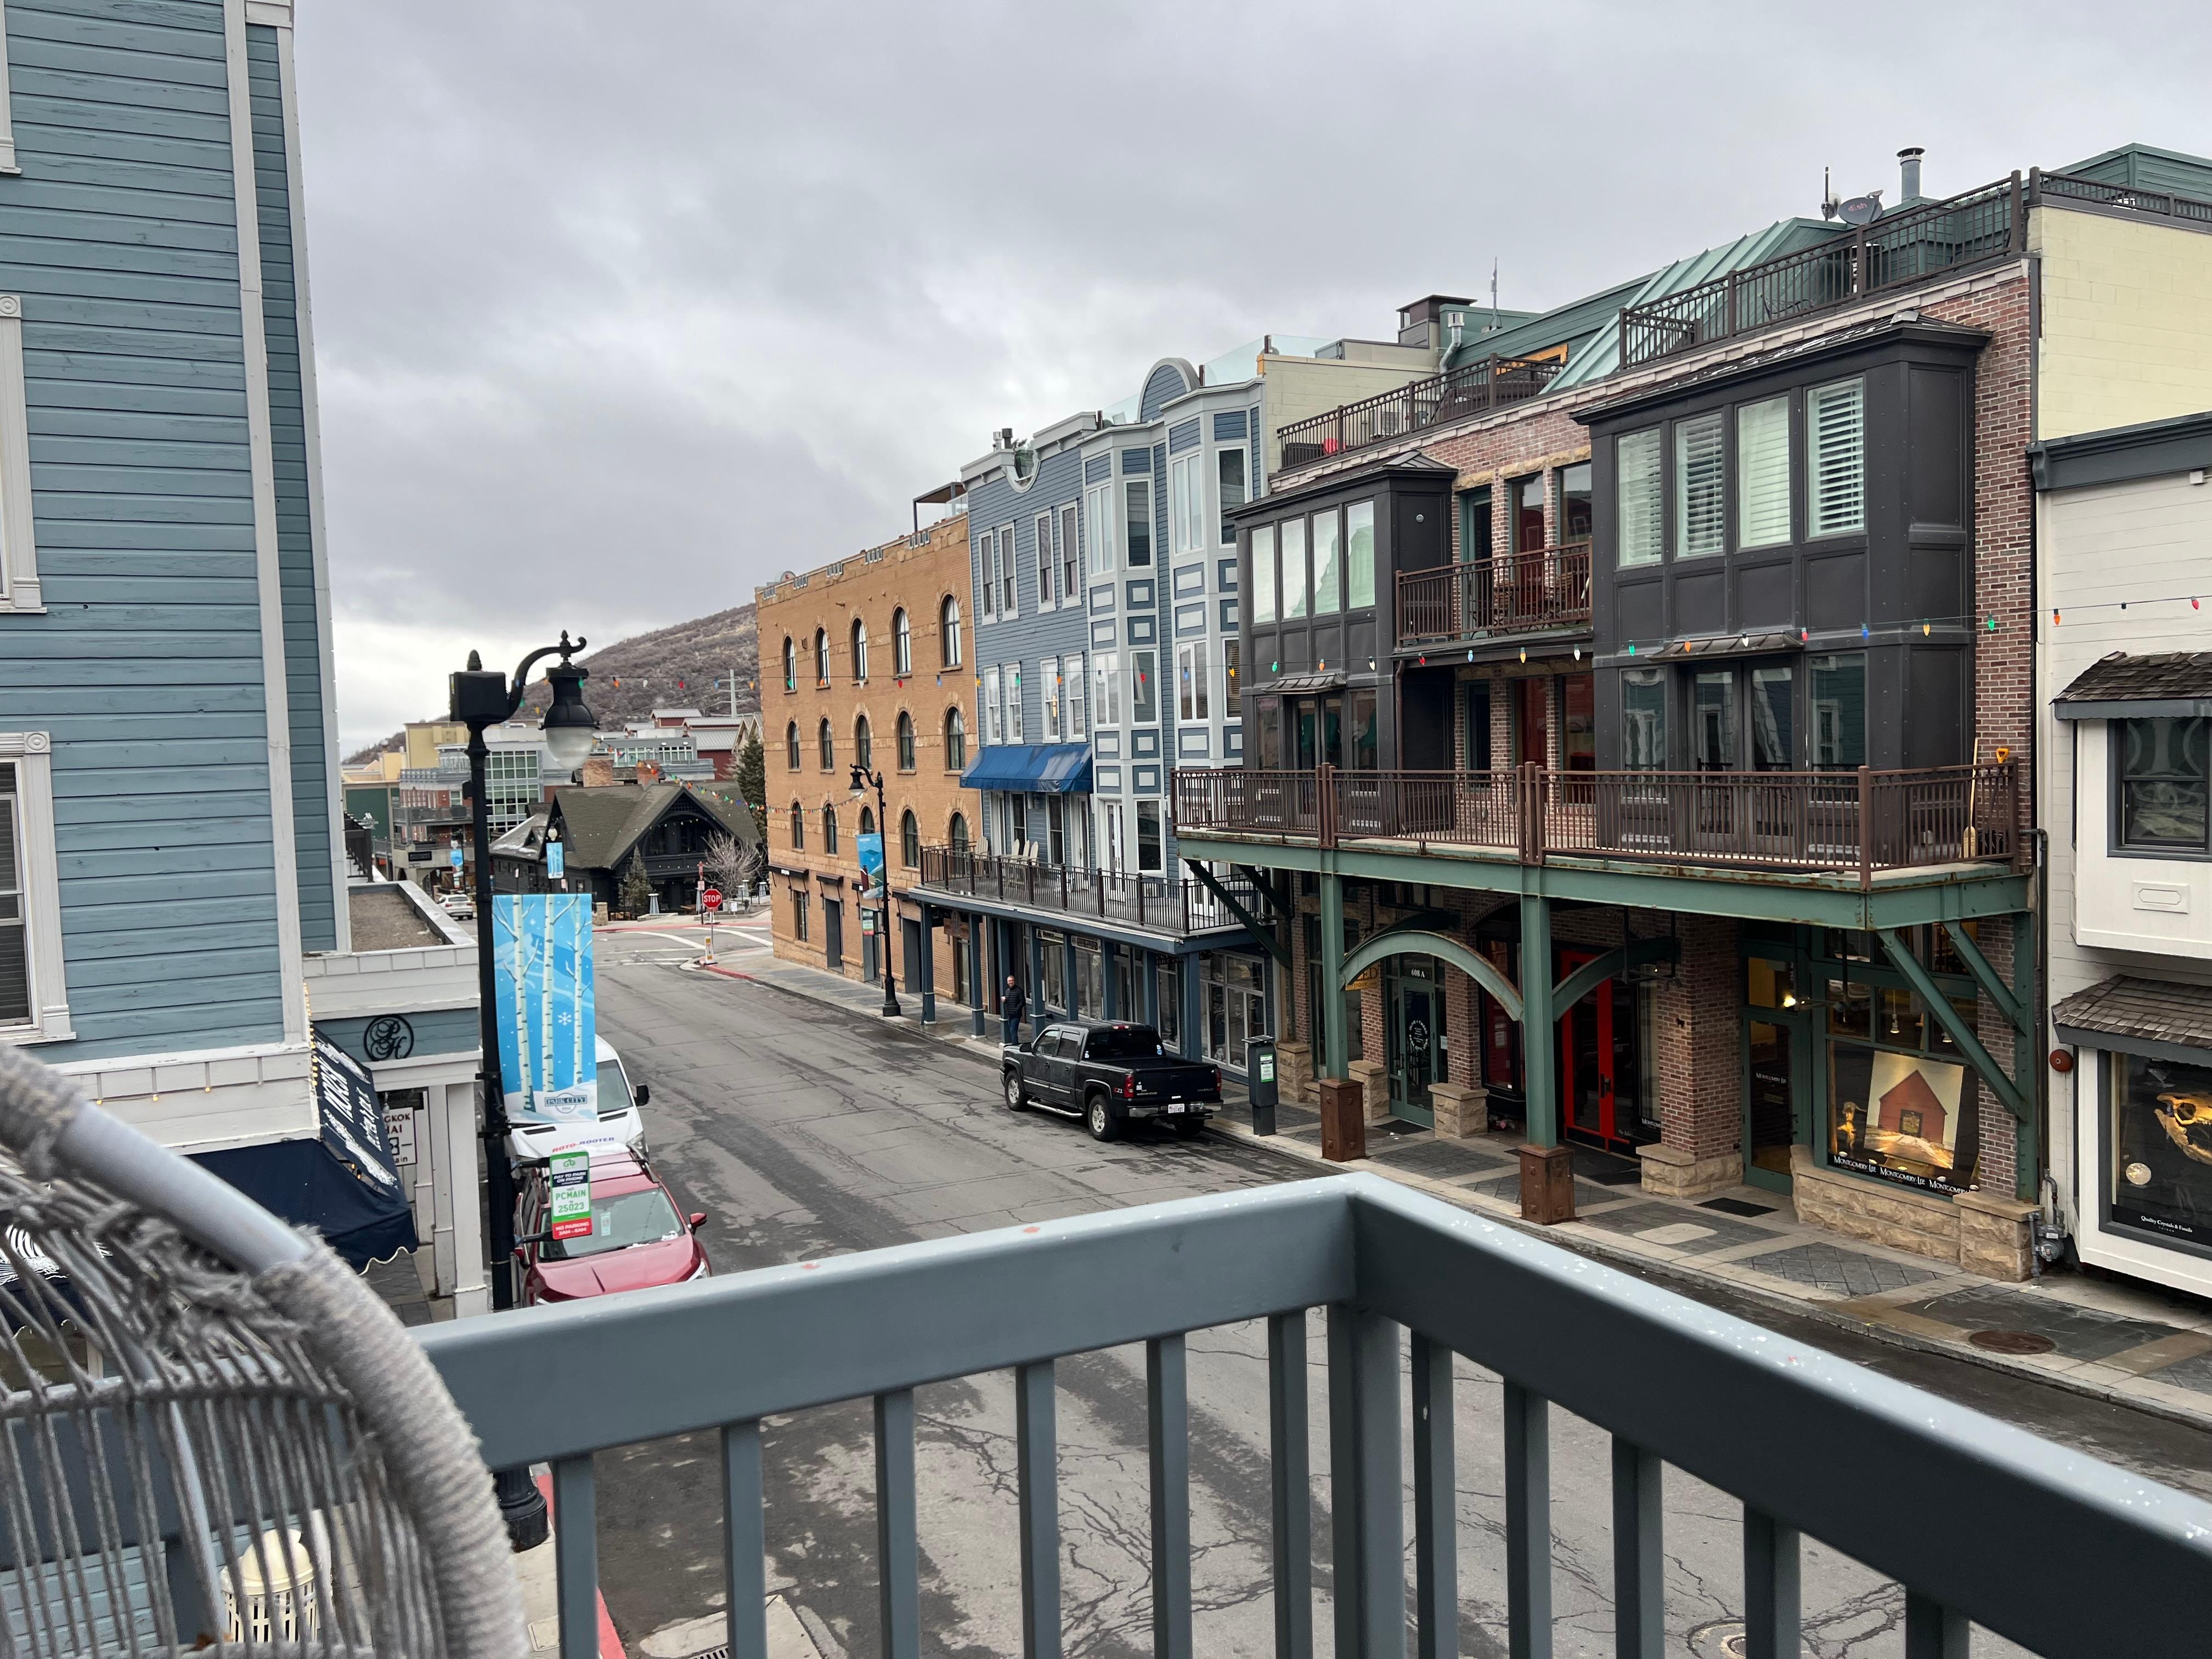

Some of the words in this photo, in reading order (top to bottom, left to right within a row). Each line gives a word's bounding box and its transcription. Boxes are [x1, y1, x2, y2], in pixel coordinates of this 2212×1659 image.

[703, 895, 721, 903] STOP
[1411, 968, 1420, 977] 608
[384, 1113, 411, 1123] GKOK
[555, 1189, 586, 1200] PCMAIN
[558, 1202, 584, 1213] 25023
[565, 1221, 589, 1229] PARKING
[2141, 1215, 2157, 1225] Quality
